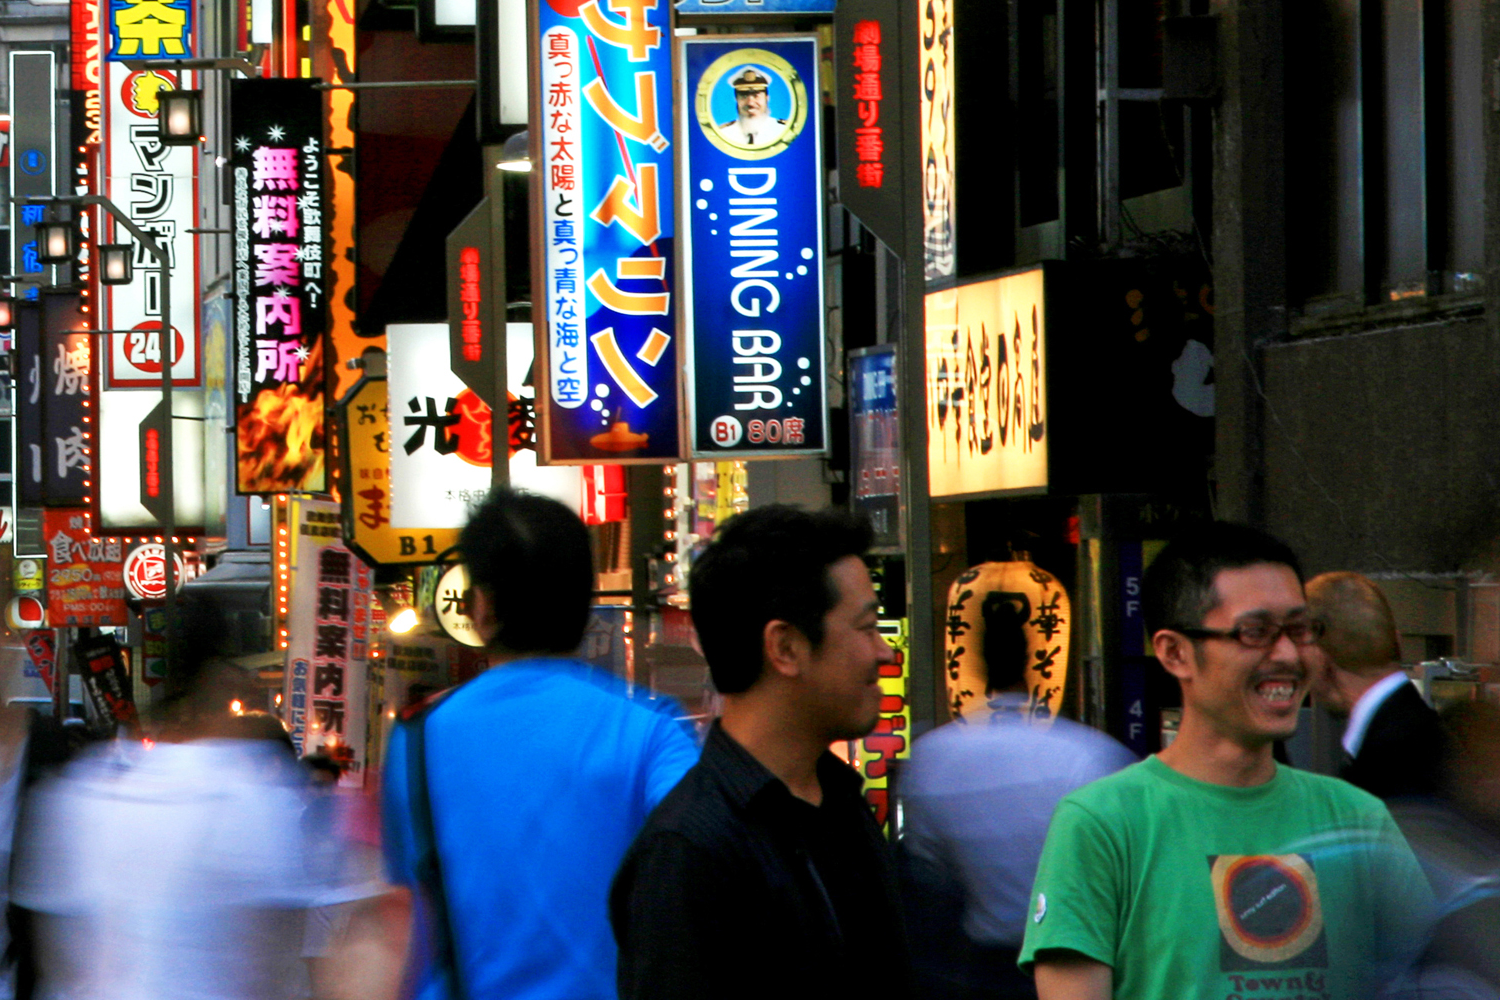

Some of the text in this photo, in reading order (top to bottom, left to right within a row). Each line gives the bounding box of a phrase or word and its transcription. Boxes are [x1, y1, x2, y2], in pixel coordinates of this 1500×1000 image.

[546, 32, 583, 404] 真っ赤な太陽と真っ青な海と空
[251, 145, 300, 385] 無料案内所
[728, 166, 783, 411] DINING BAR
[715, 421, 736, 442] B1
[398, 534, 438, 556] B1
[1126, 576, 1140, 617] 5F
[1128, 701, 1141, 742] 4F
